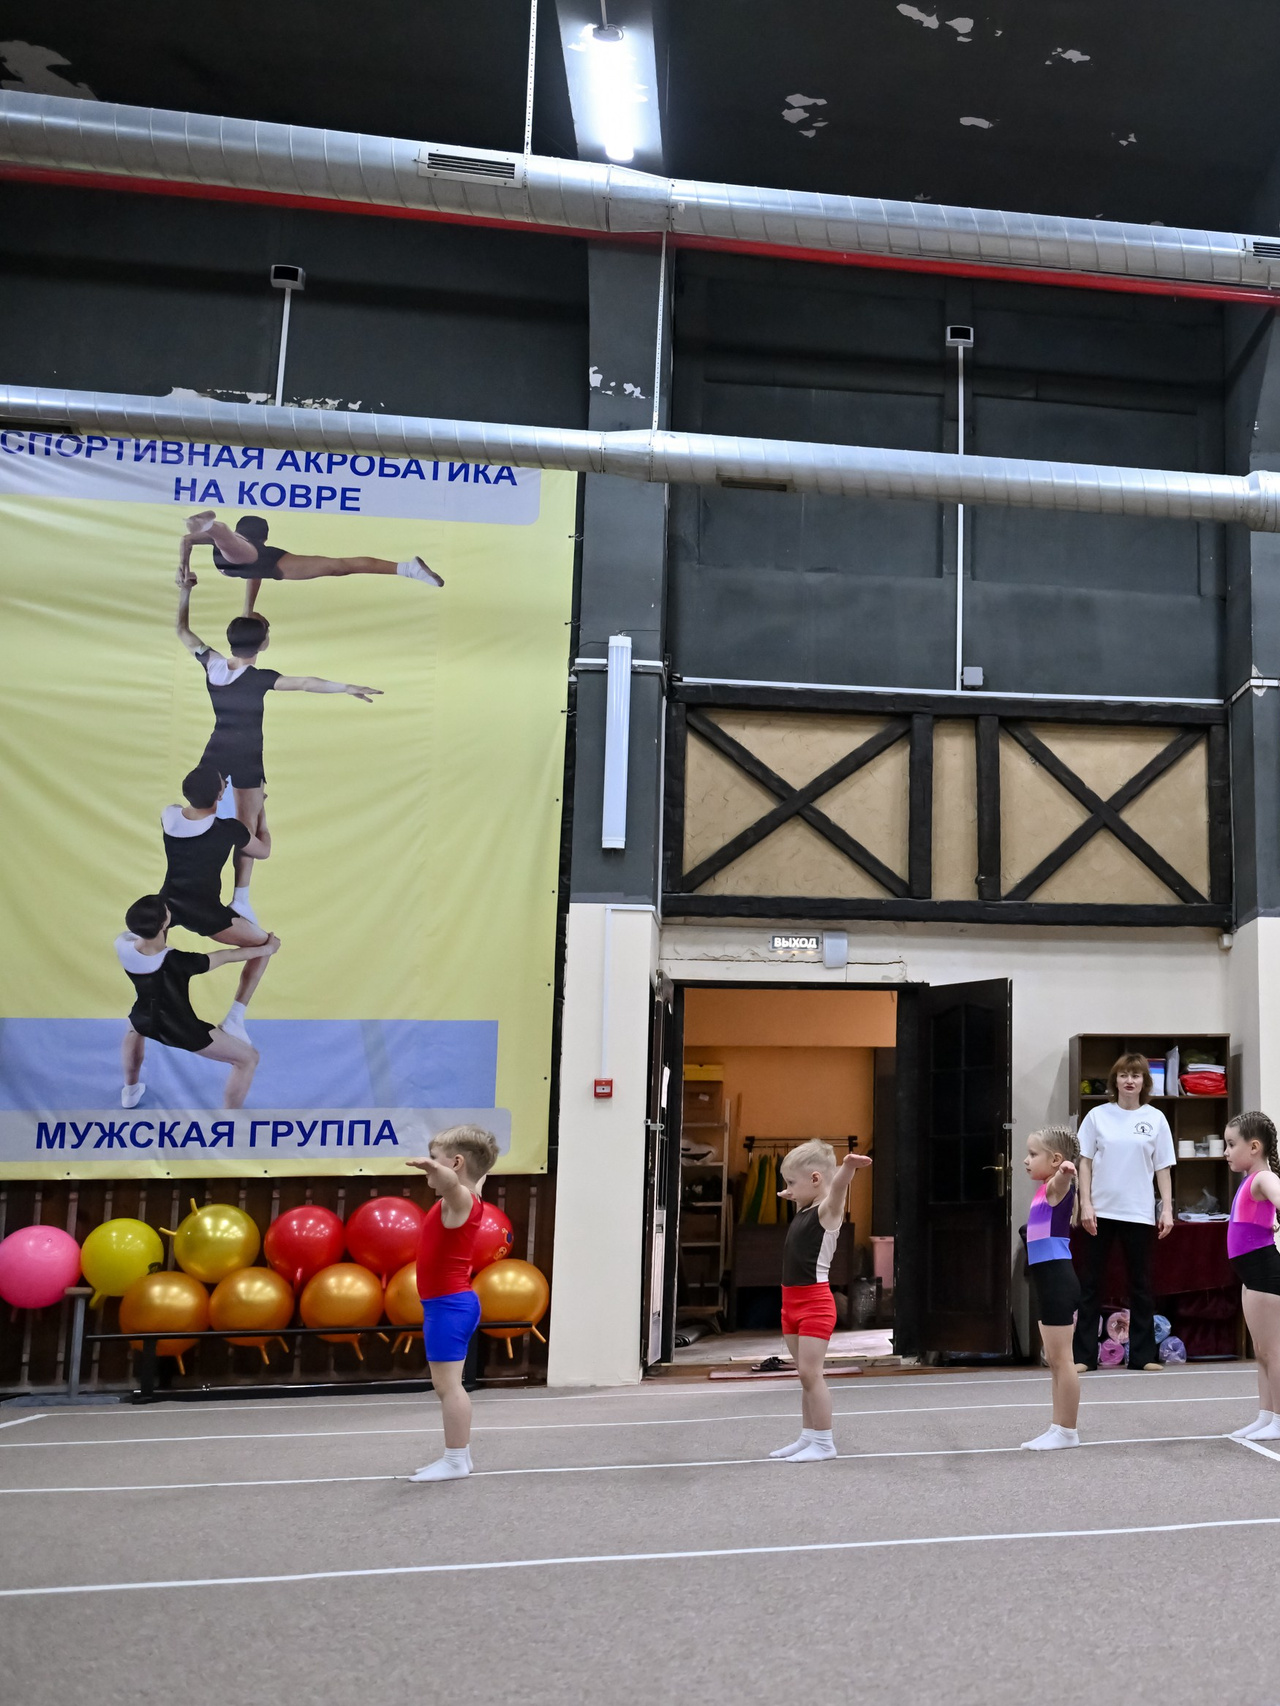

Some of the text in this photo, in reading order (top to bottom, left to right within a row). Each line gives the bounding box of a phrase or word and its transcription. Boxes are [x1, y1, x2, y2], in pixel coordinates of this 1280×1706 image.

[1, 430, 518, 486] СПОРТИВНАЯ АКРОБАТИКА
[174, 477, 362, 512] НА КОВРЕ
[773, 937, 818, 949] ВЫХОД
[35, 1119, 399, 1150] МУЖСКАЯ ГРУППА
